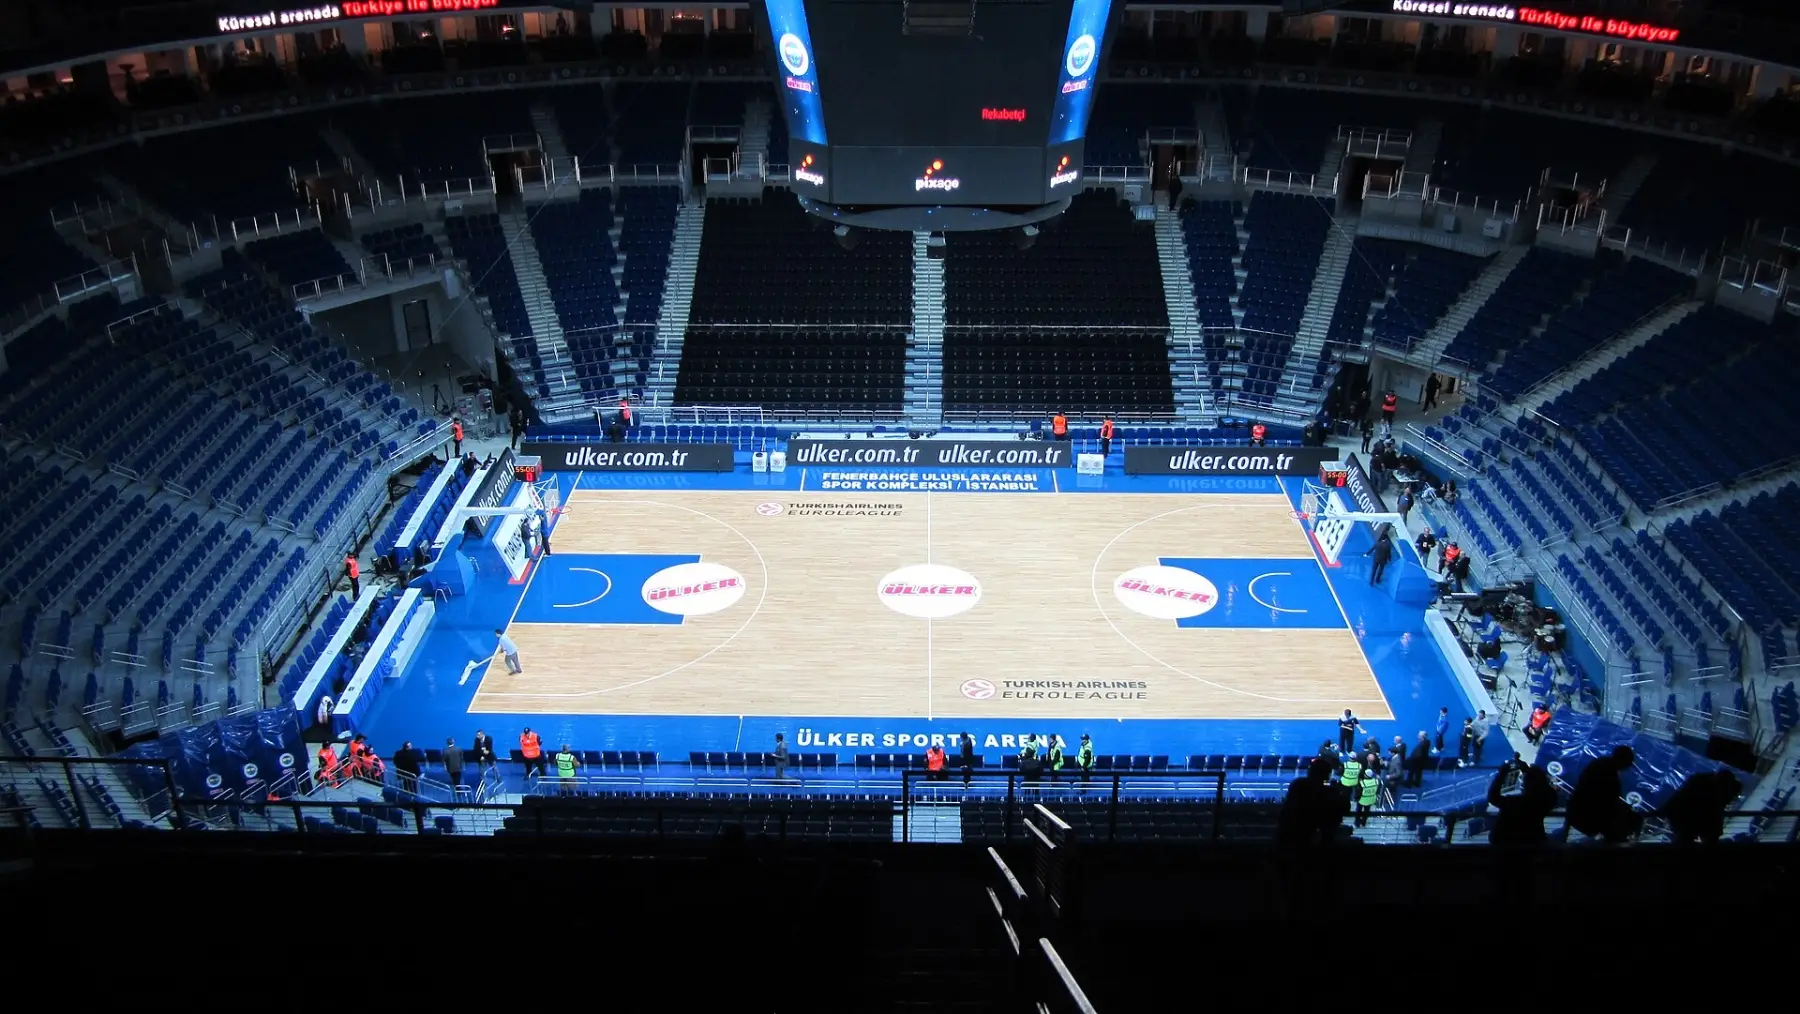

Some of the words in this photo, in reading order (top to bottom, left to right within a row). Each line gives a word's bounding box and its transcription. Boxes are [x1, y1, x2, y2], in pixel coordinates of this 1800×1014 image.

[217, 13, 277, 32] Küresel
[280, 5, 340, 25] arenada
[342, 0, 402, 16] Türkiye
[1392, 0, 1450, 14] Küresel
[1453, 4, 1515, 20] arenada
[1518, 7, 1575, 29] Türkiye
[1581, 16, 1603, 31] ile
[1607, 19, 1680, 41] büyüyor
[981, 107, 1027, 122] Rekabetçi
[796, 168, 824, 186] pixage
[915, 176, 960, 191] pixage
[1050, 170, 1078, 188] pixage
[565, 447, 689, 467] ulker.com.tr
[797, 444, 920, 464] ulker.com.tr
[938, 444, 1061, 465] ulker.com.tr
[1169, 450, 1294, 471] ulker.com.tr
[821, 481, 862, 490] SPOR
[866, 480, 951, 490] KOMPLEKSİ
[965, 480, 1038, 491] İSTANBUL
[822, 472, 919, 483] FENERBAHÇE
[922, 473, 1038, 482] ULUSLARARASI
[647, 576, 742, 601] ÜLKER
[881, 582, 978, 597] ÜLKER
[1119, 578, 1214, 606] ÜLKER
[1003, 680, 1073, 689] TURKISH
[1076, 680, 1147, 690] AIRLINES
[1002, 690, 1147, 700] EUROLEAGUE
[797, 728, 875, 747] ÜLKER
